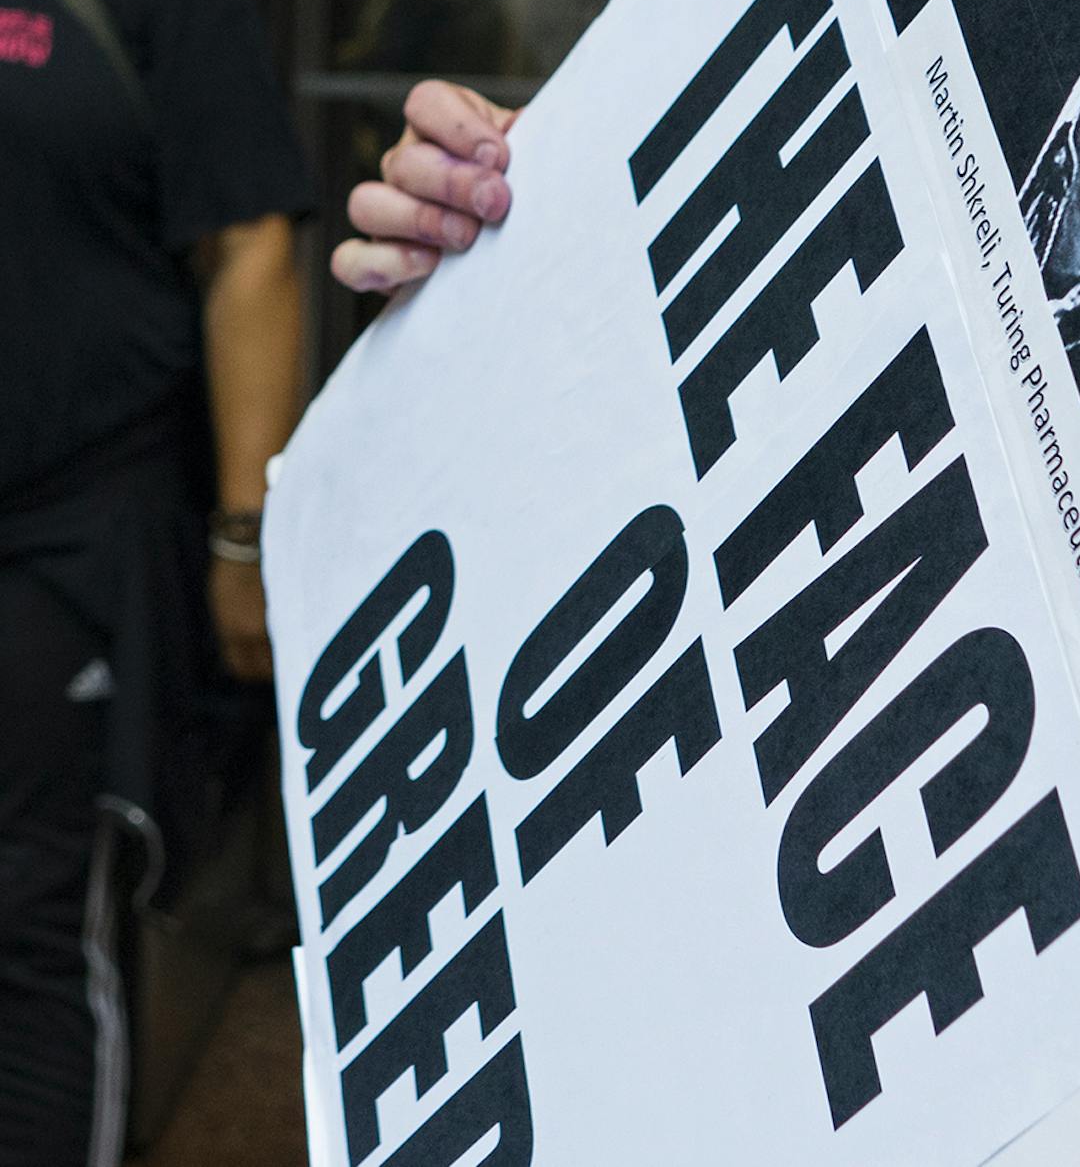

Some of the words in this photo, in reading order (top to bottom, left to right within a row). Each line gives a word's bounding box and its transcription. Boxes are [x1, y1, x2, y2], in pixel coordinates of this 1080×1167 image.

[925, 55, 965, 159] Martin
[957, 153, 1002, 269] Shkreli,
[992, 261, 1032, 372] Turing
[495, 505, 722, 887] OF
